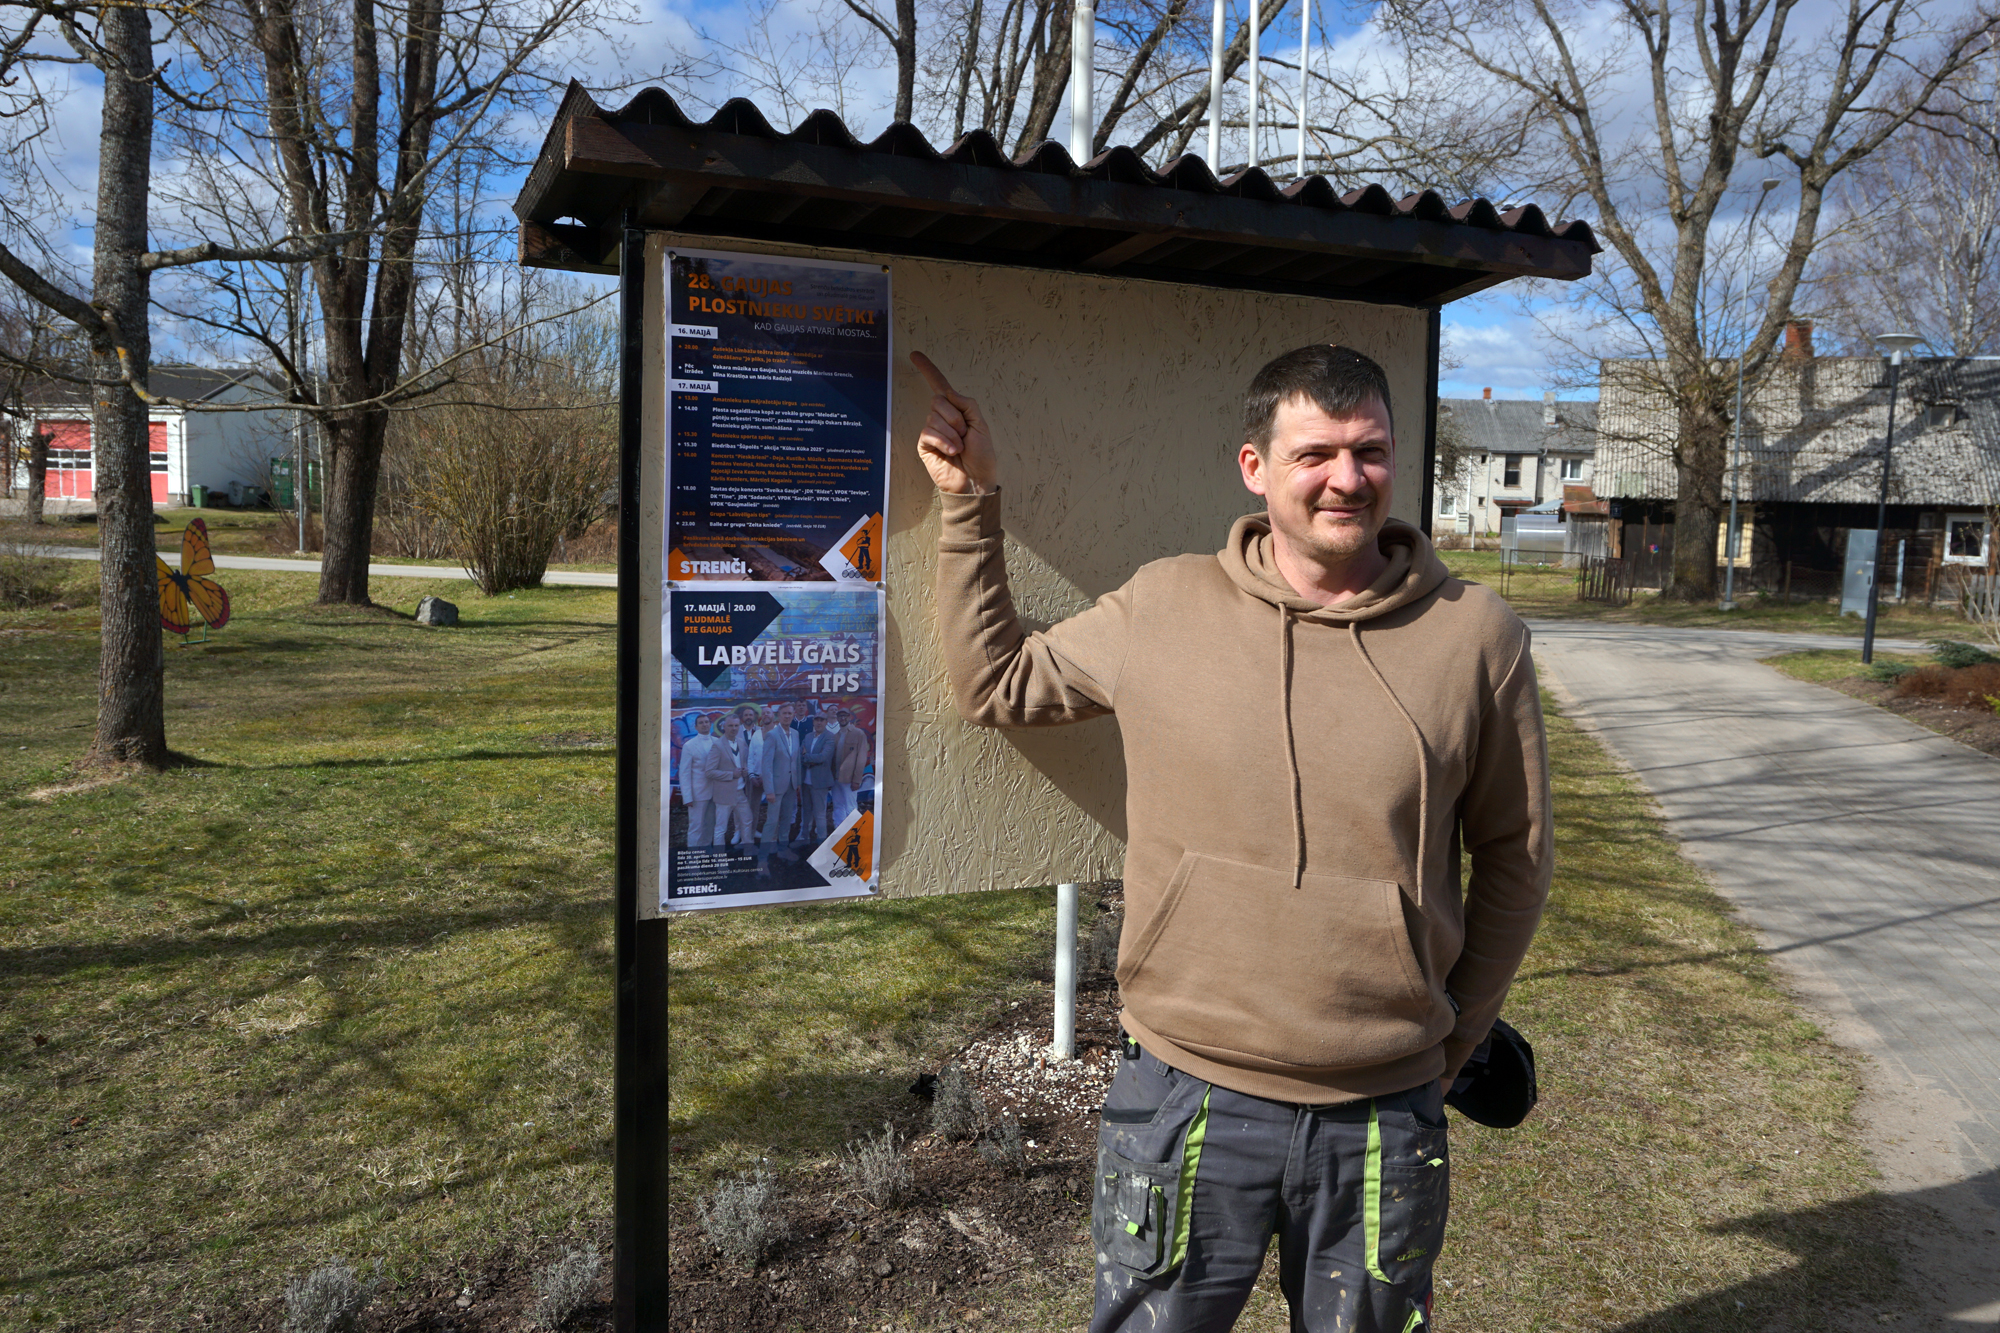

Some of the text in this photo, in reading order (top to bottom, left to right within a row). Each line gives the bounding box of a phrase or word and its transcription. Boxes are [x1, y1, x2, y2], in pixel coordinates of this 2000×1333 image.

[688, 273, 792, 298] 28. GAUJAS
[689, 296, 874, 324] PLOSTNIEKU SVĒTKI
[689, 327, 710, 336] MAIJĀ
[754, 322, 771, 330] KAD
[774, 323, 804, 334] GAUJAS
[806, 325, 834, 335] ATVARI
[689, 382, 711, 391] MAIJĀ
[699, 603, 725, 613] MAIJĀ
[684, 615, 730, 623] PLUDMALĒ
[700, 626, 732, 634] GAUJAS
[698, 641, 860, 665] LABVĒLĪGAIS
[808, 674, 860, 693] TIPS
